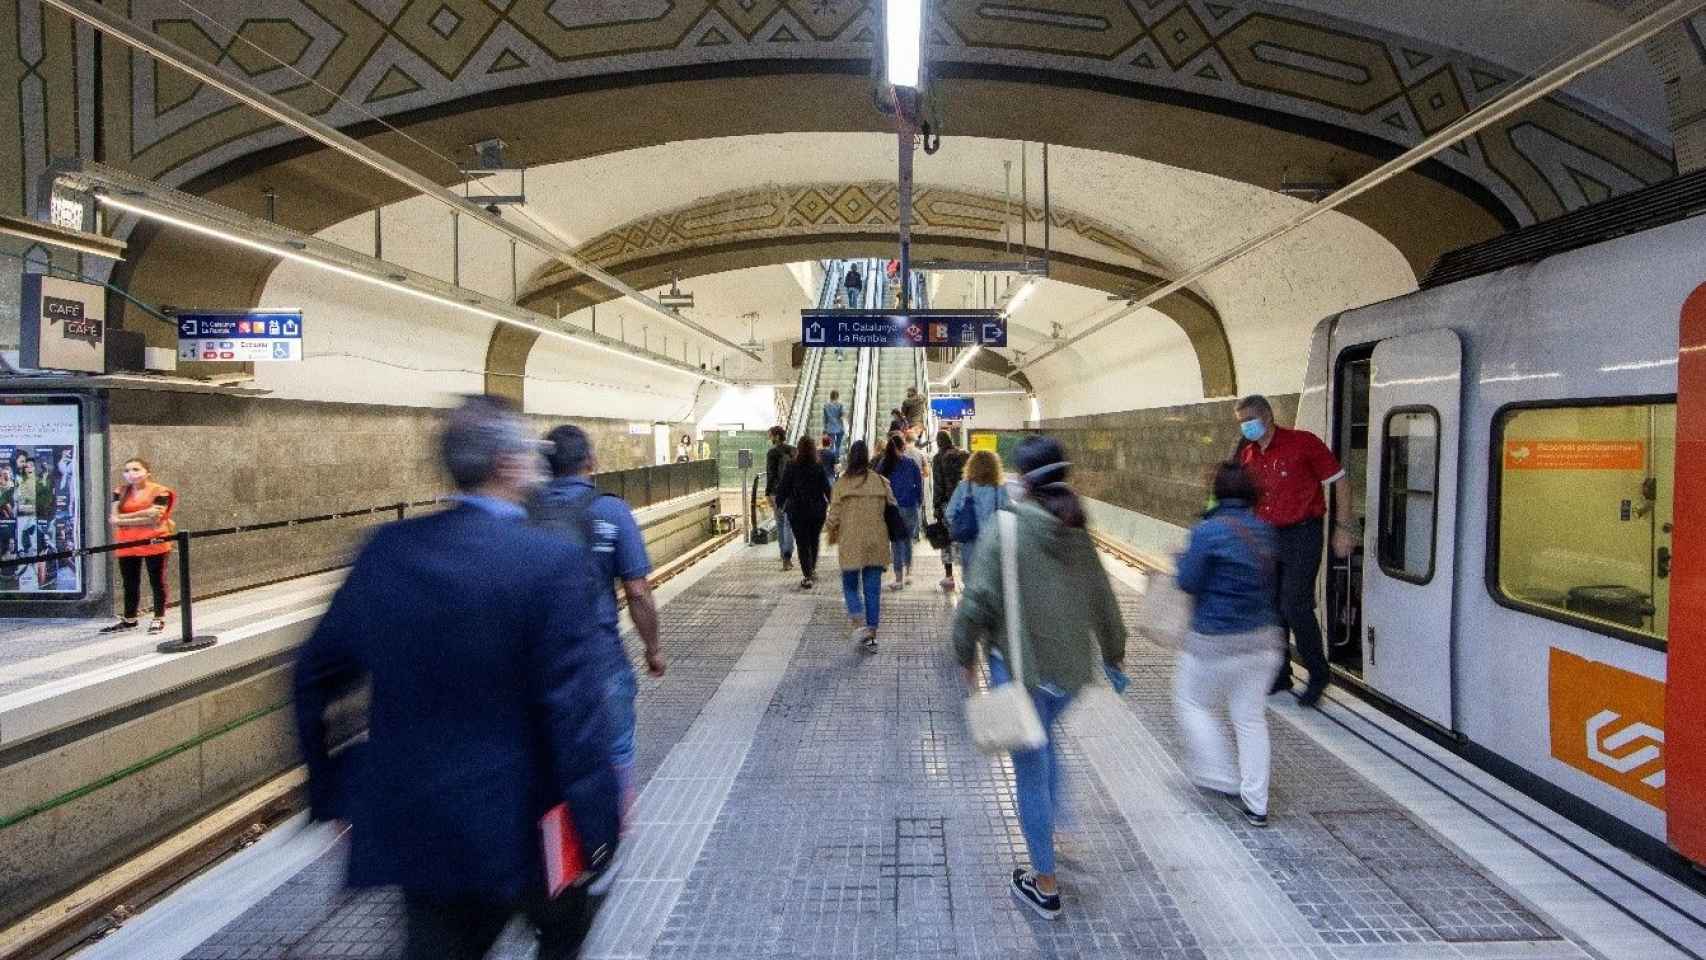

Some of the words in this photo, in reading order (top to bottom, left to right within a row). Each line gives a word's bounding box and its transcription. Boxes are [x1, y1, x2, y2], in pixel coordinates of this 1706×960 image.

[49, 303, 80, 316] CAFÉ
[838, 322, 850, 332] Pl.
[852, 322, 897, 333] Catalunya
[838, 334, 850, 343] La
[852, 333, 887, 343] Rambla
